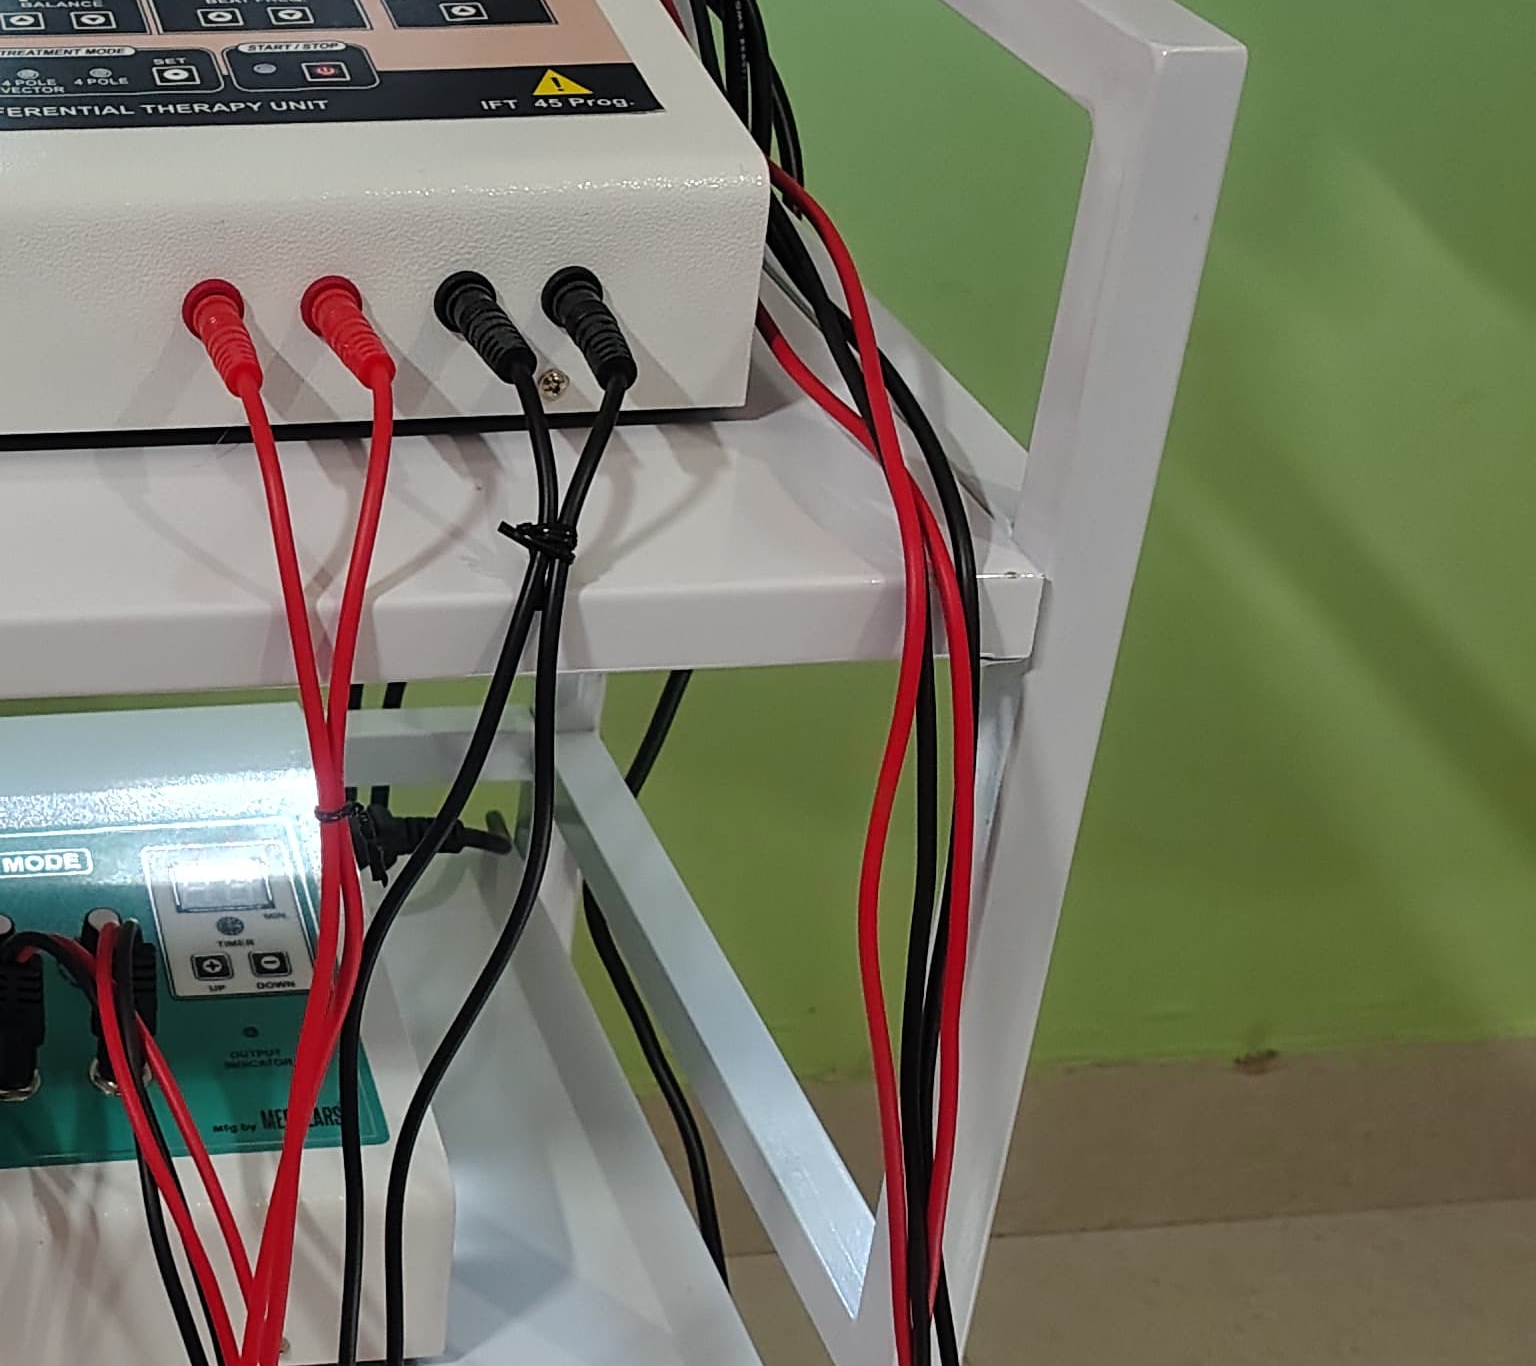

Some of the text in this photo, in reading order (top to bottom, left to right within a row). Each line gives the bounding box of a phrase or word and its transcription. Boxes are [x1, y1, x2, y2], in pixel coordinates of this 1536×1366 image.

[21, 0, 105, 8] BALANCE
[0, 48, 82, 56] TREATMENT
[16, 78, 56, 86] POLE
[73, 77, 128, 86] 4 POLE
[0, 86, 65, 94] VECTOR
[141, 101, 262, 114] THERAPY
[270, 100, 329, 111] UNIT
[480, 97, 635, 110] IFT 45 Prog.
[2, 851, 83, 873] MODE
[217, 938, 255, 947] TIMER
[256, 981, 296, 990] DOWN
[229, 1049, 281, 1059] OUTPUT
